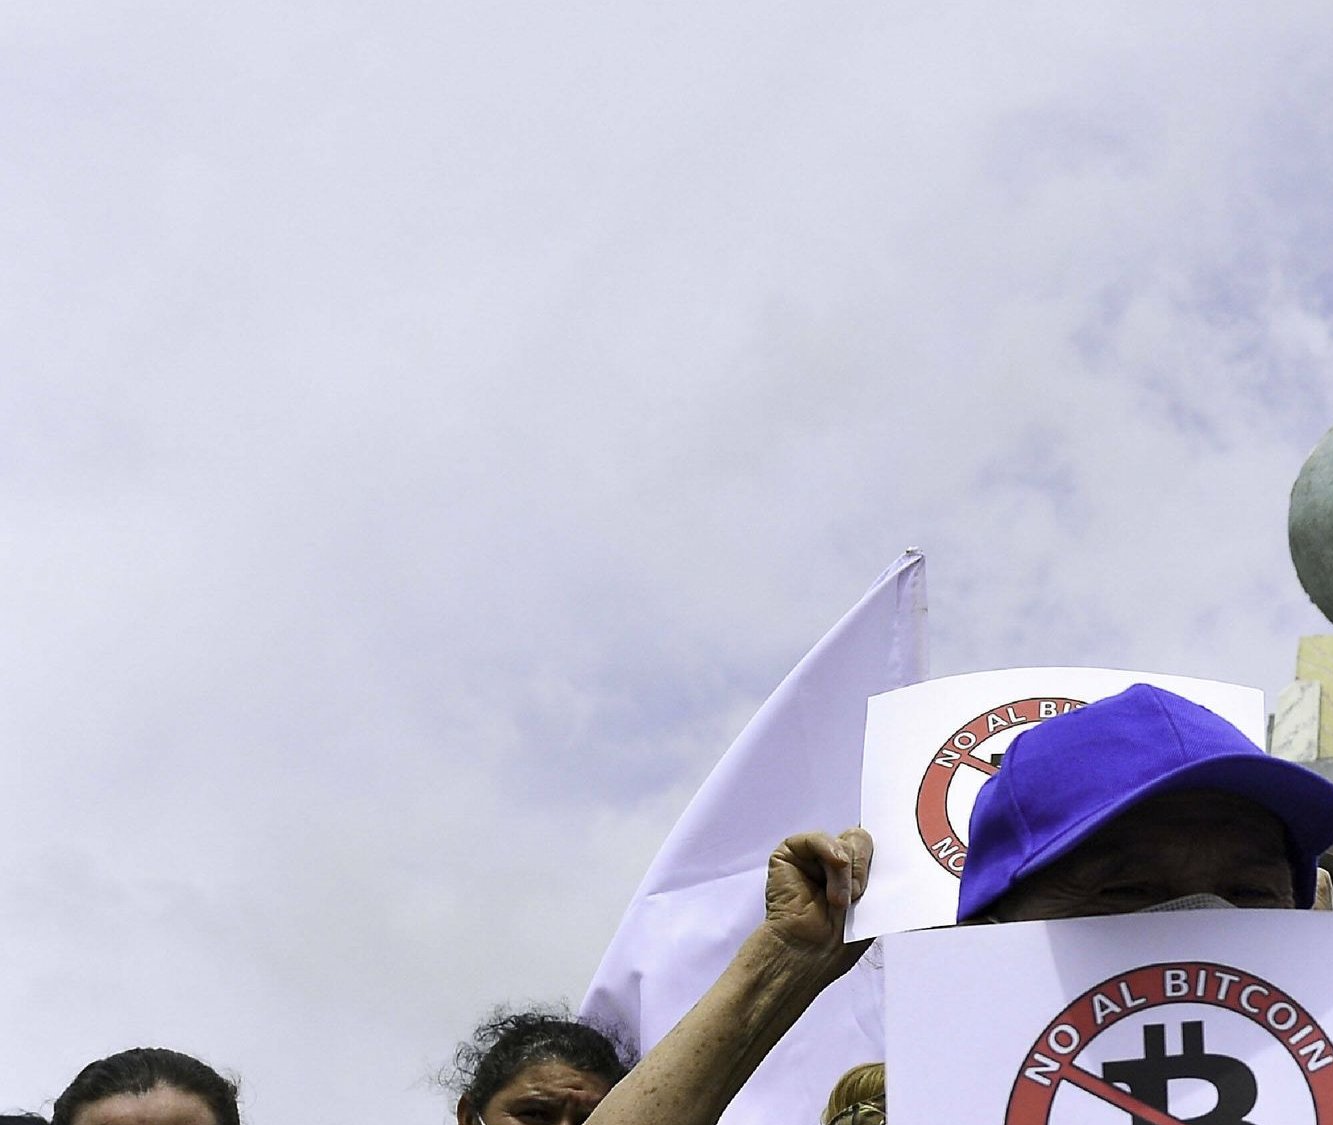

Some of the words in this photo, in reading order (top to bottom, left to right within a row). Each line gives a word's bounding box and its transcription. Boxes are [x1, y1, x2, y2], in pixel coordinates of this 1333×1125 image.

[935, 731, 976, 768] NO
[986, 706, 1026, 732] AL
[1039, 701, 1088, 718] BI
[1024, 1024, 1080, 1087] NO
[1091, 982, 1147, 1025] AL
